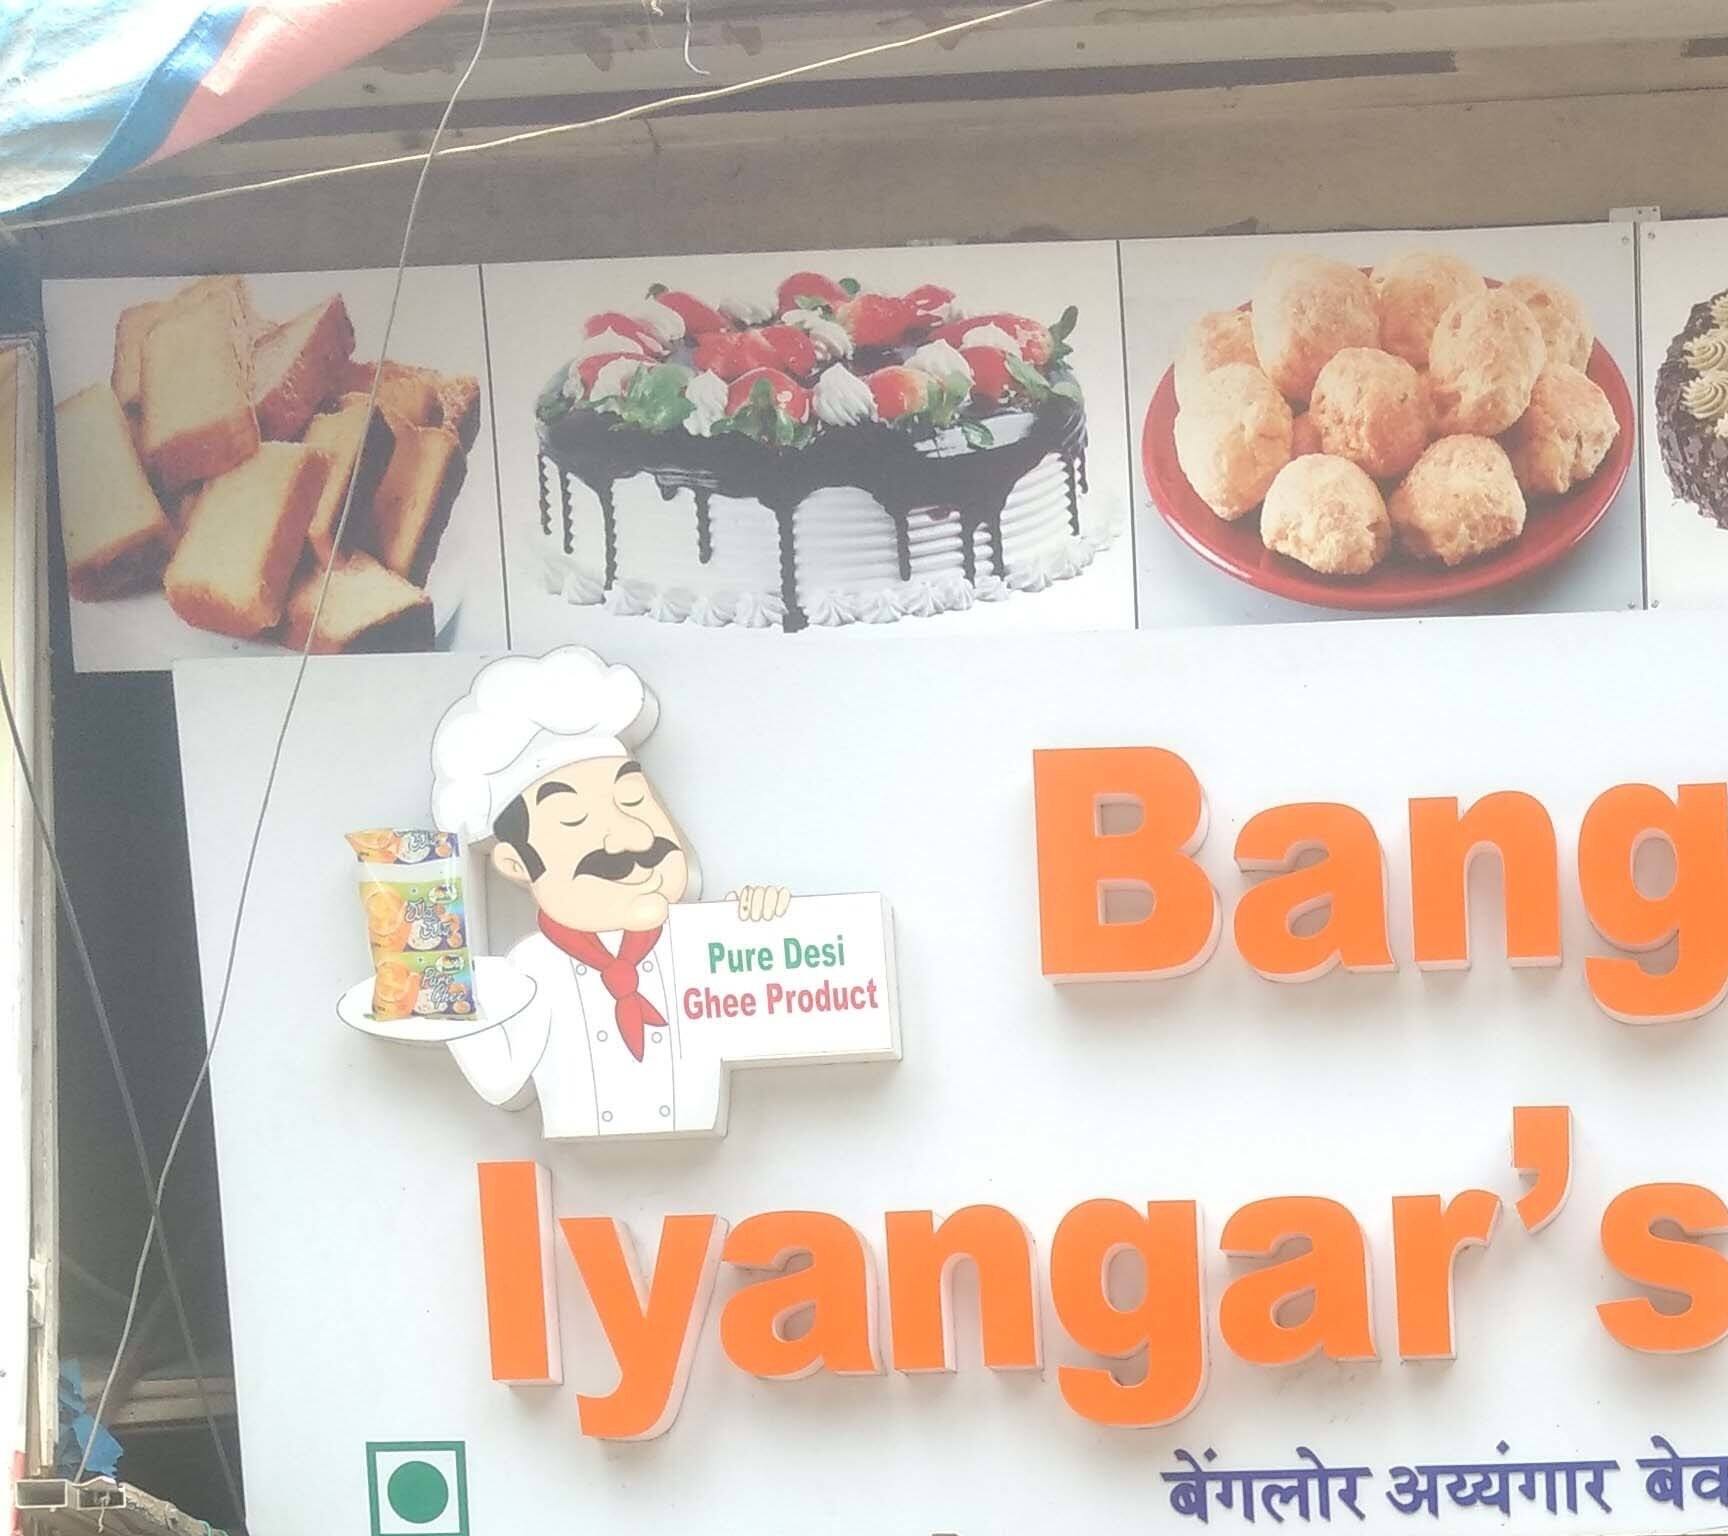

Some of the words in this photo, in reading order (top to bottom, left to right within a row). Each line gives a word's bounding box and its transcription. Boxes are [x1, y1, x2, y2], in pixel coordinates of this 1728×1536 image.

[708, 942, 774, 974] Pure
[783, 934, 845, 969] Desi
[683, 986, 757, 1020] Ghee
[766, 978, 879, 1015] Product
[1159, 1446, 1373, 1524] बेंगलोर
